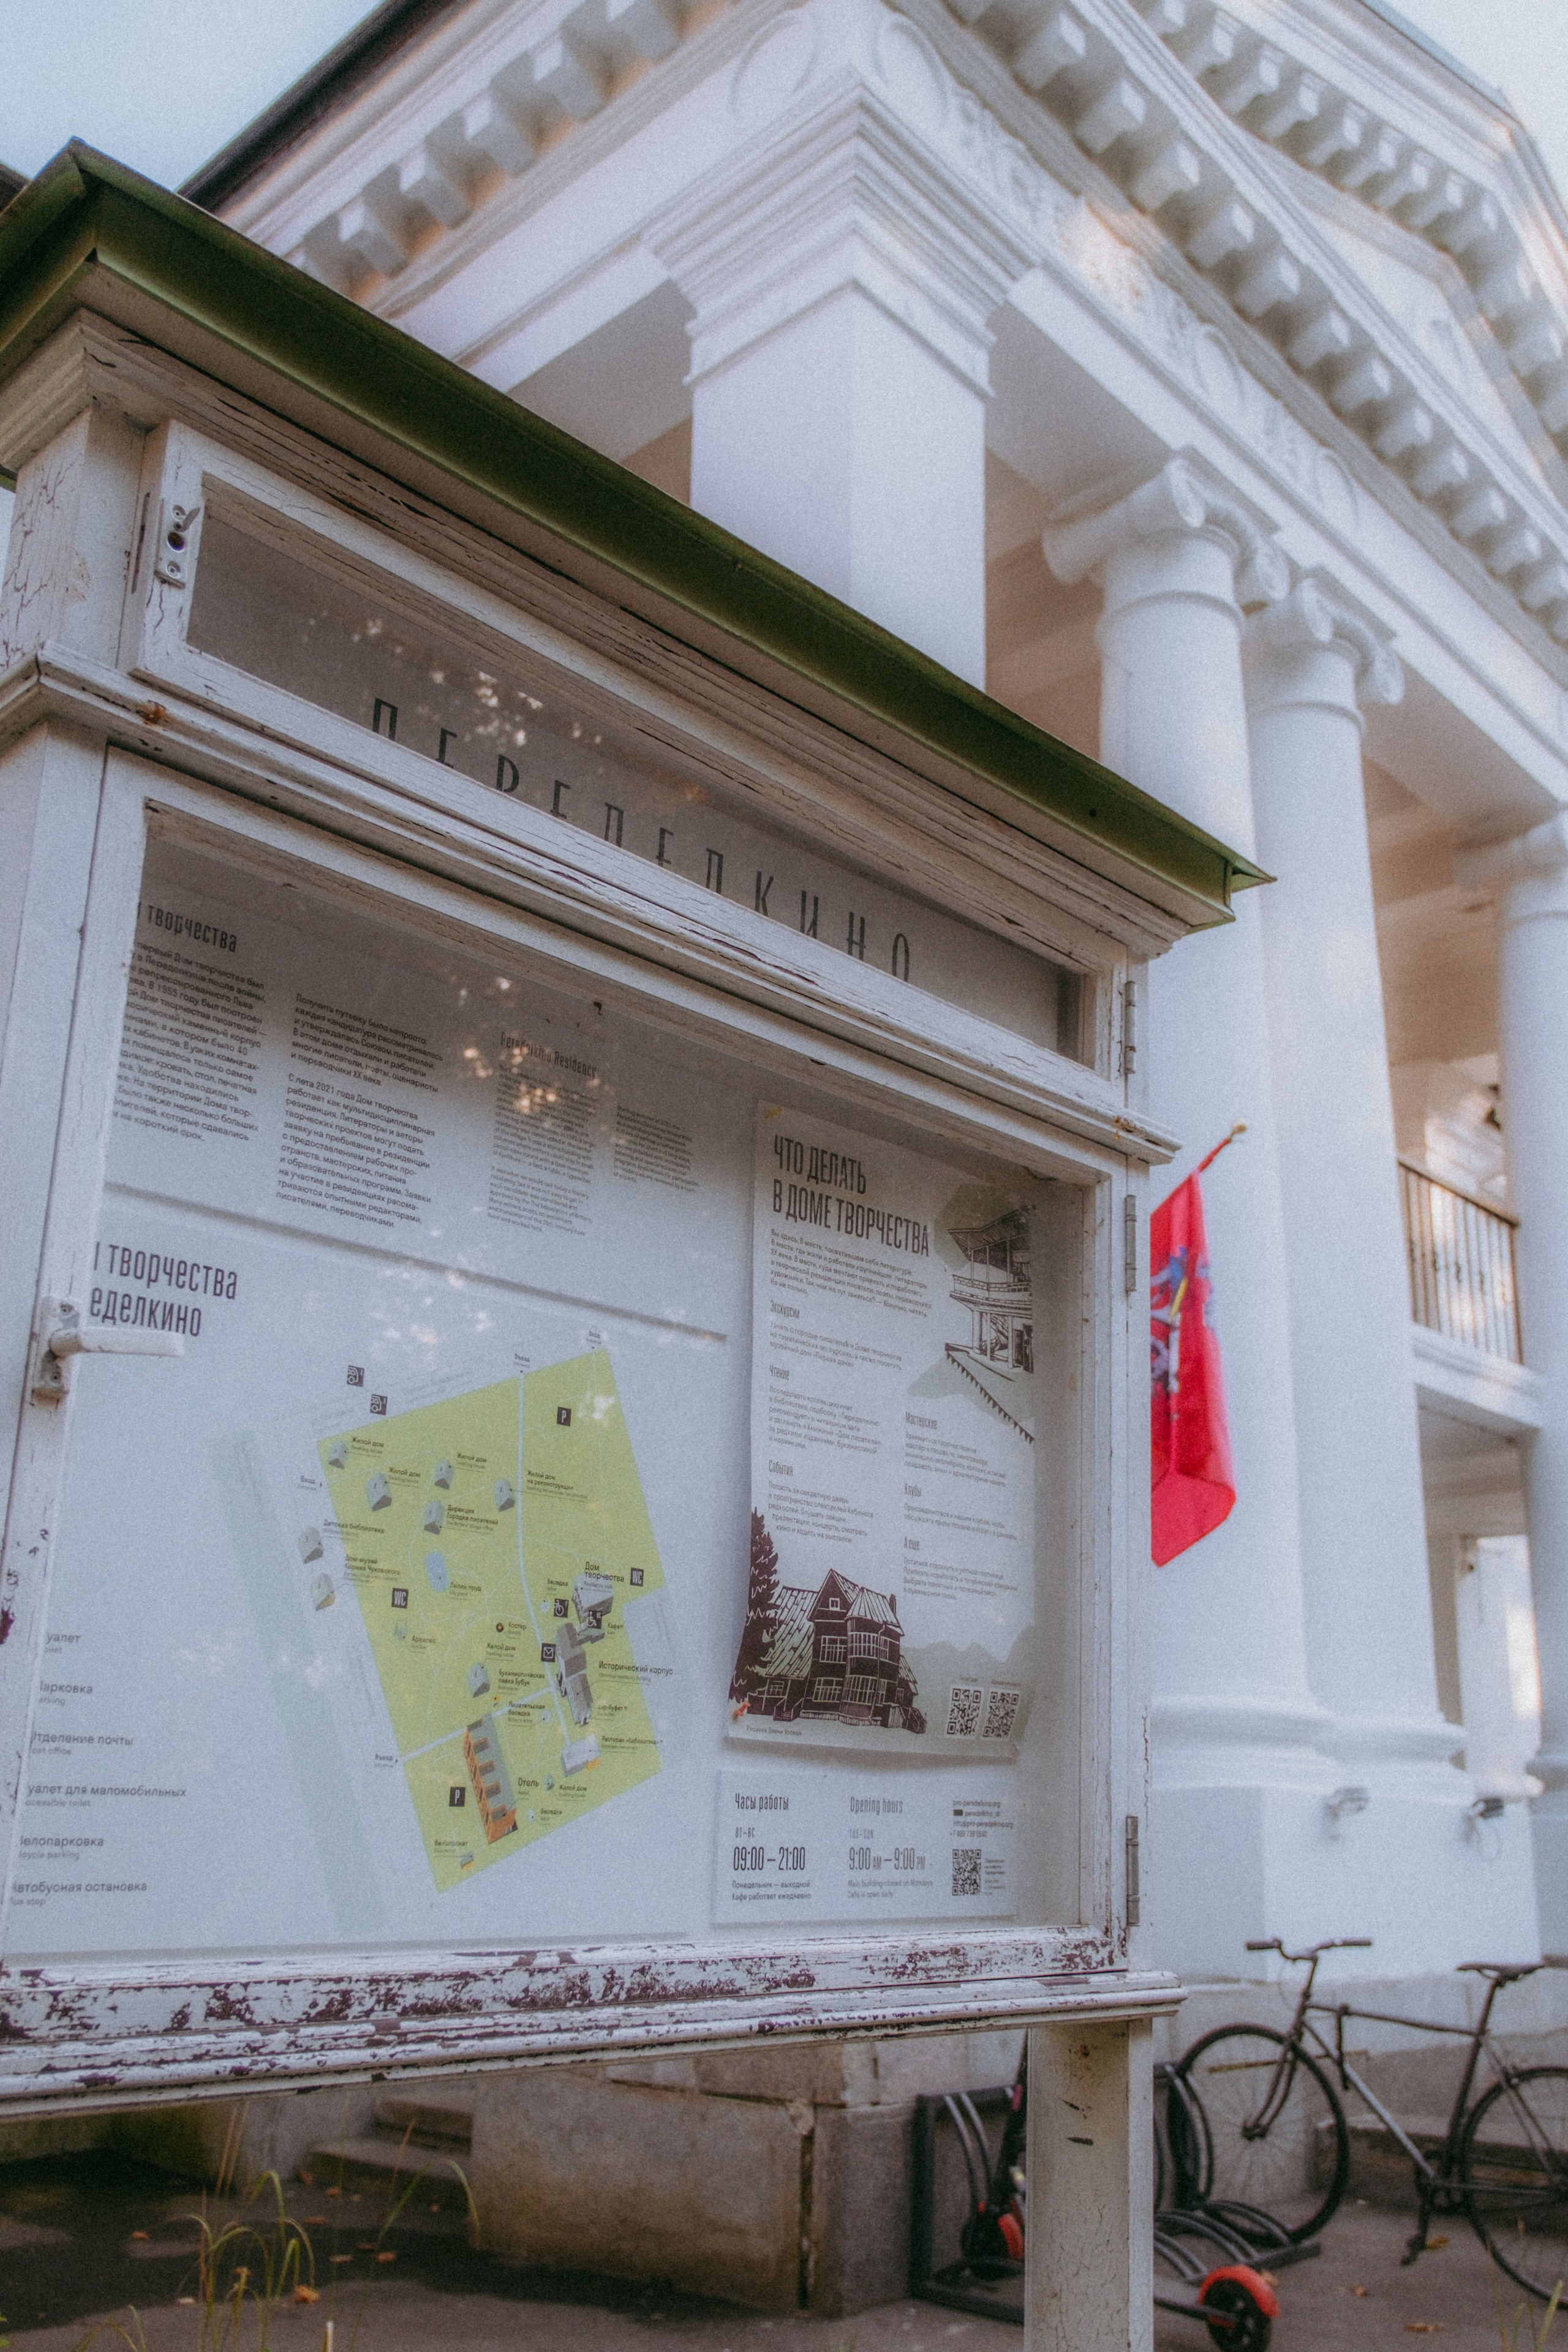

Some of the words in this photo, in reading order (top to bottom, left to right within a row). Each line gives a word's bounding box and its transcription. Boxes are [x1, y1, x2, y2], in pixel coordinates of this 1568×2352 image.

[148, 905, 236, 952] творчества
[148, 981, 154, 989] В
[156, 983, 177, 997] 1955
[179, 992, 199, 1006] году
[200, 997, 219, 1011] был
[220, 1005, 262, 1027] построен
[169, 1024, 209, 1045] котором
[211, 1037, 234, 1052] было
[237, 1045, 247, 1056] 40
[132, 1038, 192, 1065] помещалось
[193, 1057, 224, 1073] только
[225, 1067, 253, 1082] самое
[183, 1041, 189, 1050] В
[189, 1044, 215, 1060] узких
[216, 1052, 259, 1072] комнатах-
[293, 1027, 298, 1036] В
[300, 1030, 320, 1044] этом
[321, 1038, 343, 1052] доме
[344, 1044, 382, 1066] отдыхали
[390, 1059, 426, 1080] работали
[554, 1051, 597, 1078] Residency
[292, 1039, 323, 1055] многие
[324, 1050, 363, 1071] писатели,
[391, 1072, 438, 1095] сценаристы
[298, 1053, 352, 1078] переводчики
[288, 1073, 293, 1082] С
[295, 1076, 314, 1088] лета
[315, 1082, 334, 1095] 2021
[336, 1089, 355, 1102] года
[356, 1094, 372, 1108] Дом
[374, 1101, 418, 1122] творчества
[287, 1085, 325, 1105] работает
[326, 1098, 341, 1108] как
[342, 1102, 435, 1138] мультидисциплинарная
[284, 1109, 333, 1131] творческих
[334, 1123, 372, 1142] проектов
[374, 1135, 396, 1150] могут
[398, 1142, 424, 1158] подать
[289, 1134, 364, 1163] предоставлением
[366, 1155, 398, 1172] рабочих
[399, 1166, 417, 1178] про-
[774, 1134, 804, 1175] ЧТО
[807, 1145, 866, 1194] ДЕЛАТЬ
[374, 1170, 406, 1185] питания
[773, 1178, 782, 1213] В
[786, 1184, 832, 1229] ДОМЕ
[836, 1198, 929, 1256] ТВОРЧЕСТВА
[110, 1245, 237, 1300] творчества
[91, 1287, 202, 1336] еделкино
[770, 1299, 800, 1322] Экскурсии
[769, 1364, 790, 1381] Чтение
[527, 1469, 544, 1479] Жилой
[769, 1459, 793, 1477] События
[584, 1561, 599, 1572] Дом
[584, 1570, 624, 1585] творчества
[632, 1570, 642, 1585] WC
[394, 1591, 407, 1606] WC
[47, 1632, 80, 1646] уалет
[598, 1660, 648, 1674] Исторический
[649, 1665, 673, 1676] корпус
[33, 1731, 94, 1745] тделение
[28, 1784, 62, 1796] уалет
[518, 1777, 539, 1787] Отель
[735, 1793, 755, 1809] Часы
[759, 1794, 788, 1812] работы
[850, 1796, 880, 1815] Opening
[882, 1797, 903, 1813] hours
[20, 1836, 104, 1849] елопарковка
[733, 1846, 764, 1871] 09:00
[778, 1846, 805, 1870] 21:00
[849, 1847, 870, 1870] 9:00
[873, 1856, 881, 1870] AM
[894, 1847, 914, 1869] 9:00
[916, 1856, 925, 1869] PM
[732, 1880, 772, 1888] Понедельник
[731, 1892, 747, 1901] Кафе
[748, 1893, 775, 1901] работает
